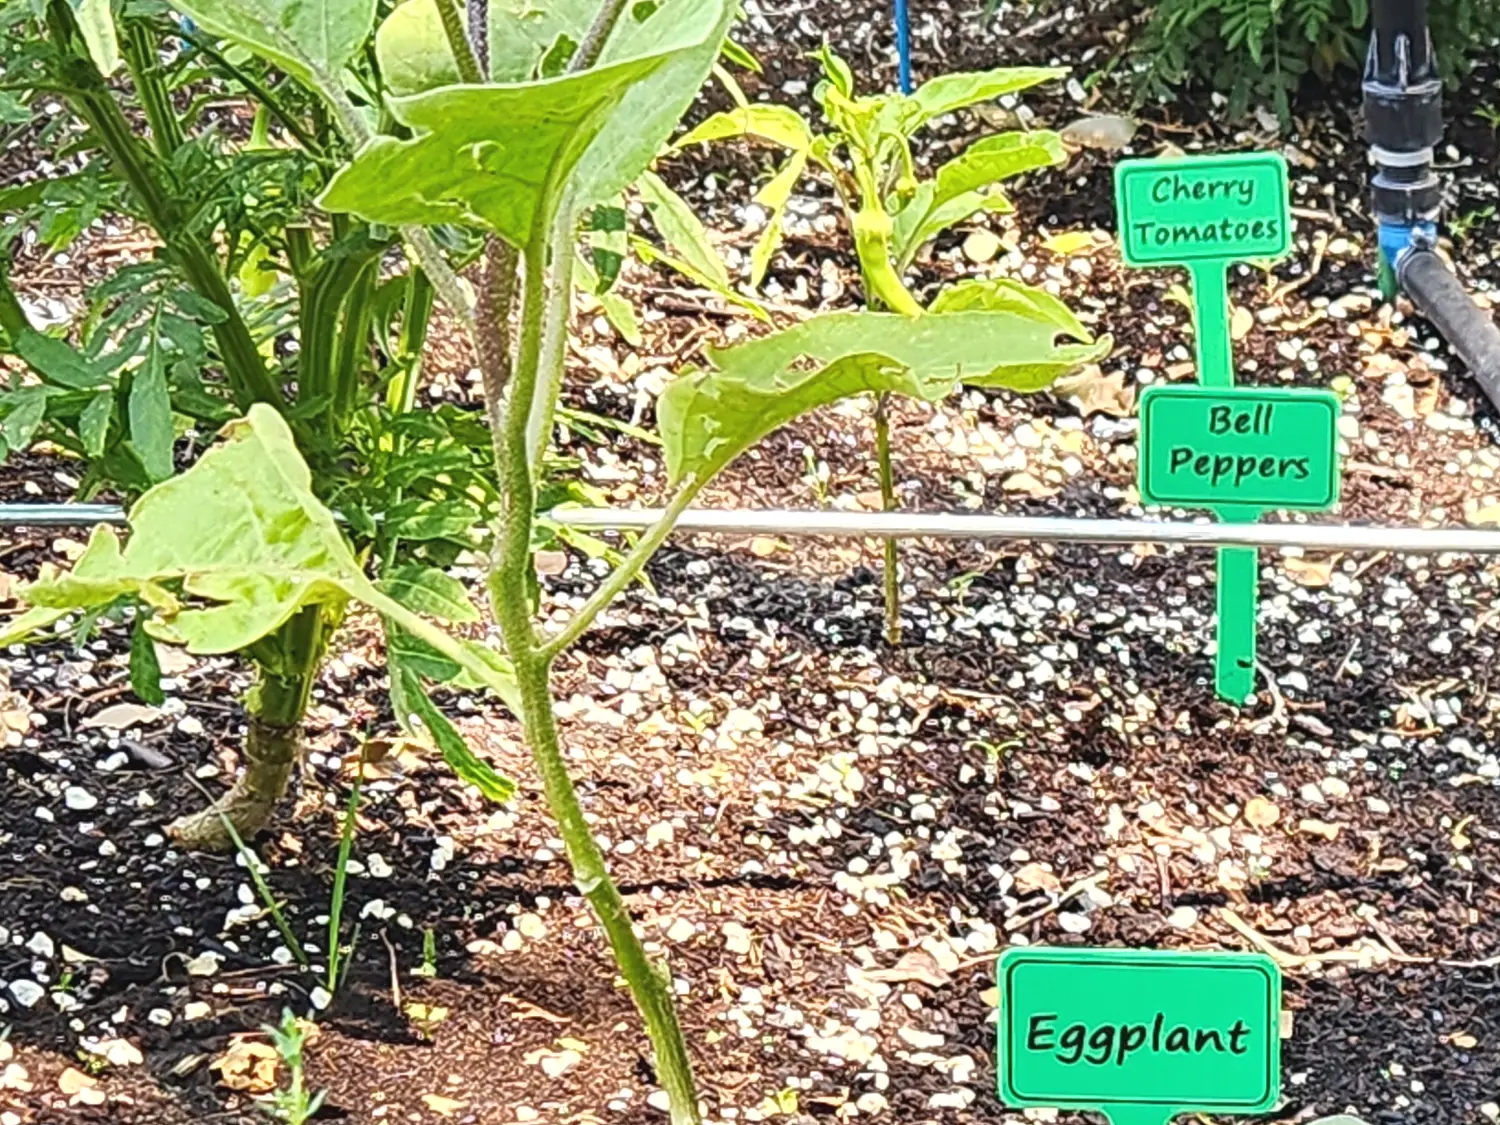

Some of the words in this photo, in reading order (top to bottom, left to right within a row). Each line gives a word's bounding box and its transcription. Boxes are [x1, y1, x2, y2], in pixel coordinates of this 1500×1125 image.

[1152, 174, 1254, 206] Cherry
[1134, 215, 1277, 246] Tomatoes
[1209, 403, 1272, 435] Bell
[1169, 447, 1310, 488] Peppers
[1027, 1012, 1250, 1066] Eggplant
